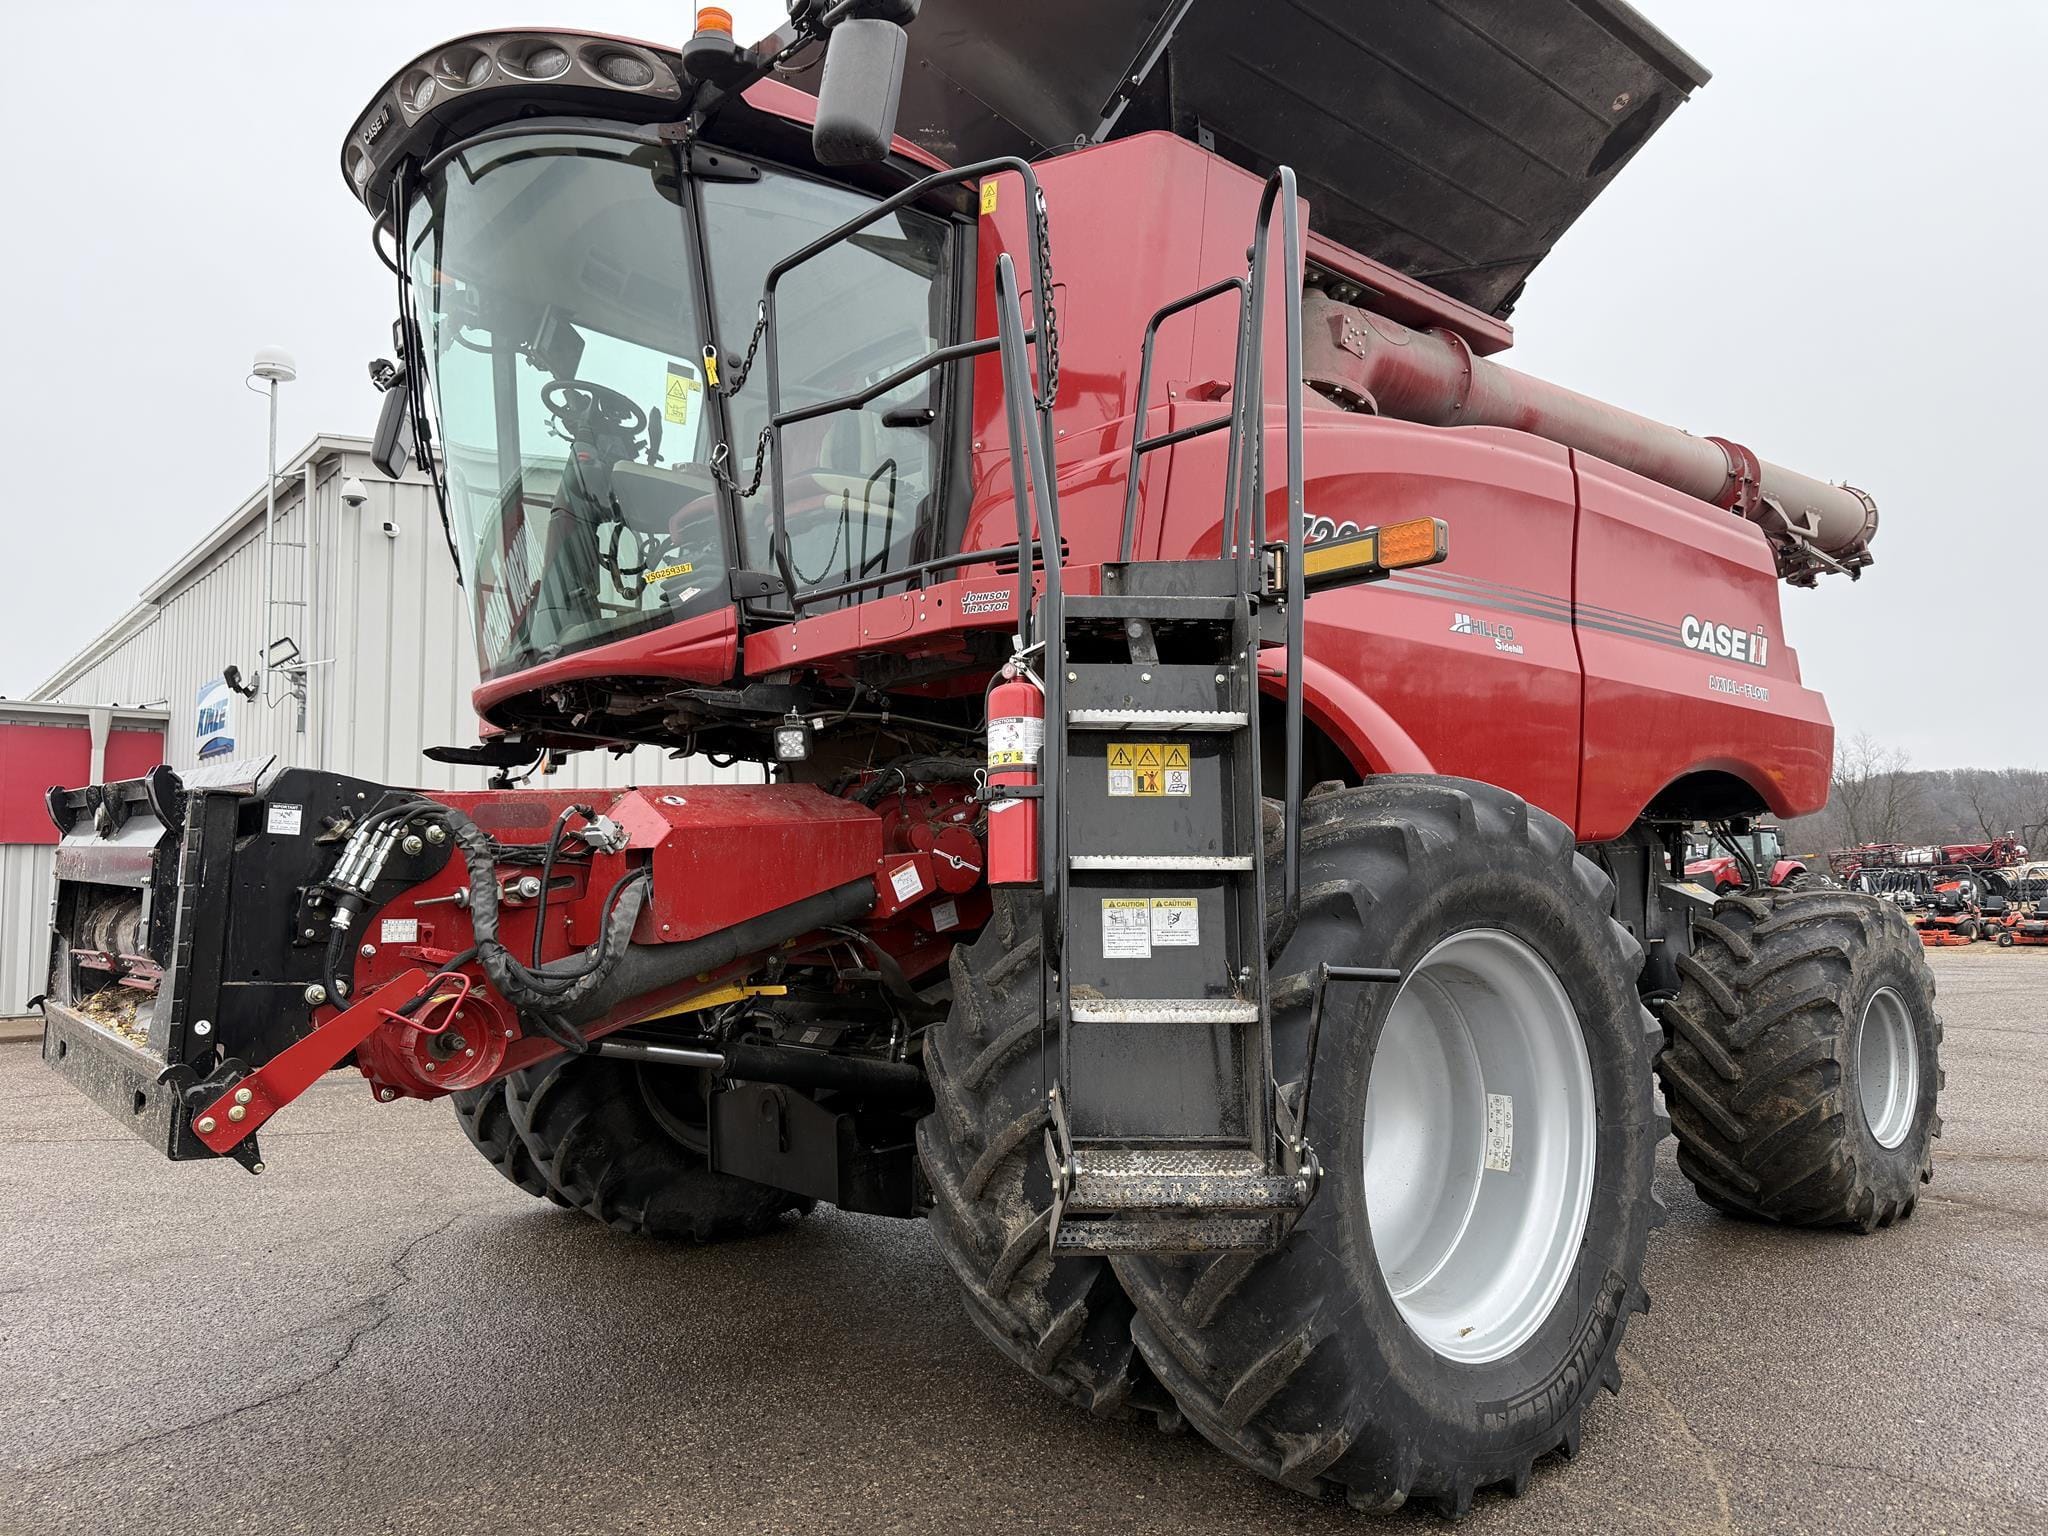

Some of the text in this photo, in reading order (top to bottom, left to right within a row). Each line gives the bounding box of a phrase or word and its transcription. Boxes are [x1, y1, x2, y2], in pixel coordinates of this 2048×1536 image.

[363, 117, 383, 145] CASE
[961, 590, 1010, 603] JOHNSON
[962, 601, 1009, 614] TRACTOR
[1470, 618, 1514, 641] HILLCO
[1681, 614, 1748, 661] CASE
